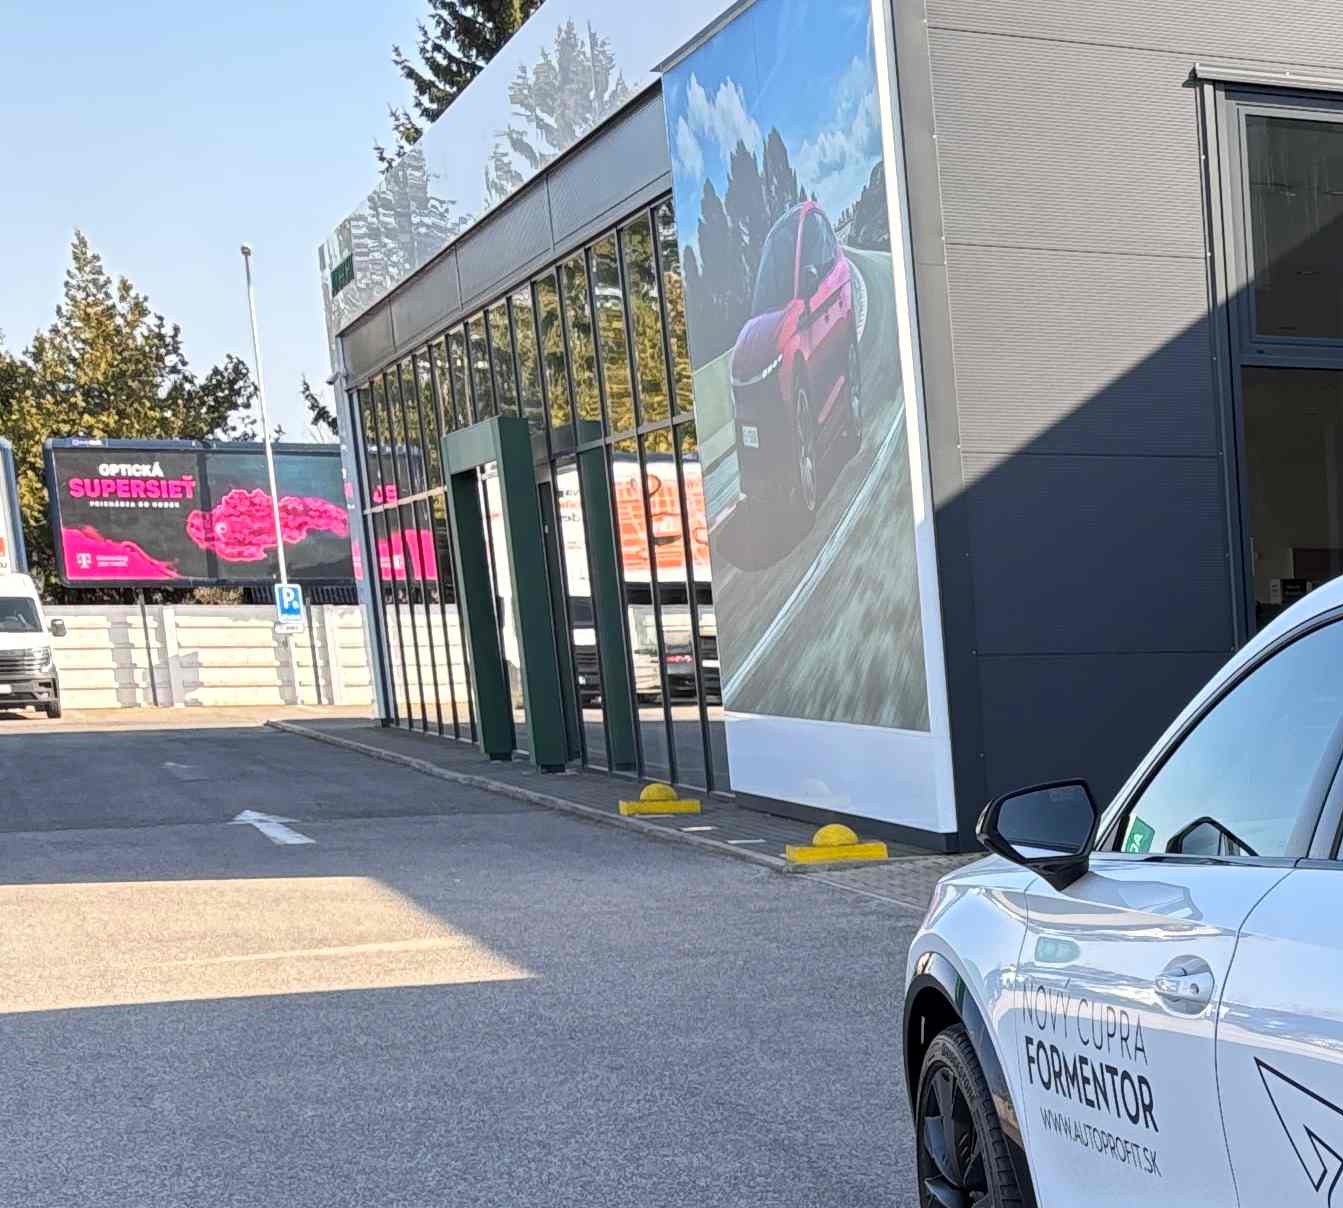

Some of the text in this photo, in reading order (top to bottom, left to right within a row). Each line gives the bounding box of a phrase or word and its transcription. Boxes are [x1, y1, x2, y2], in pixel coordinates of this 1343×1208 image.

[69, 474, 196, 499] SUPERSIEŤ
[98, 461, 165, 477] OPTICKÁ
[1022, 976, 1149, 1065] NOVÝ CUPRA
[1025, 1035, 1159, 1133] FORMENTOR
[1040, 1106, 1163, 1177] WWW.AUTOPROFIT.SK
